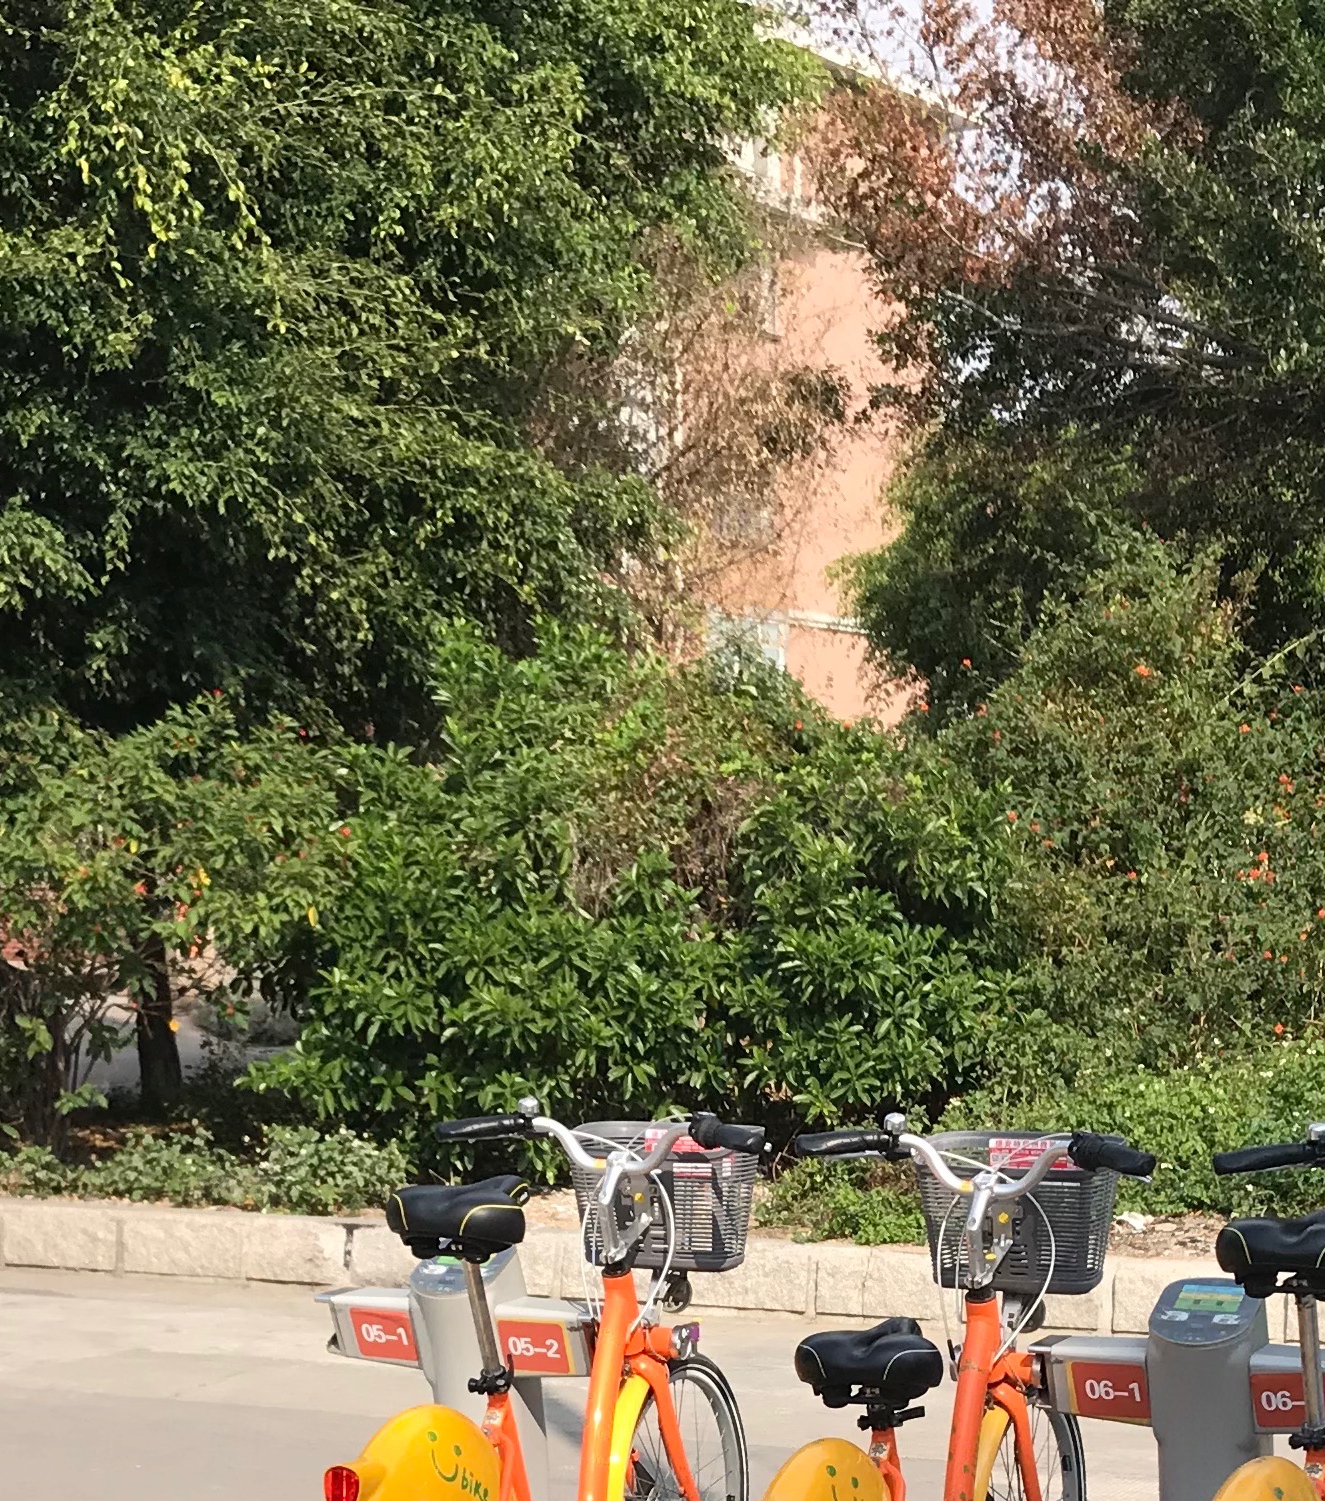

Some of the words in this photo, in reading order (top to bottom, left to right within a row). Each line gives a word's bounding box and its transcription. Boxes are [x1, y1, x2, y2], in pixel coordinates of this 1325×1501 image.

[361, 1323, 409, 1346] 05-1
[508, 1336, 562, 1359] 05-2
[1085, 1379, 1142, 1402] 06-1
[1260, 1391, 1307, 1411] 06-
